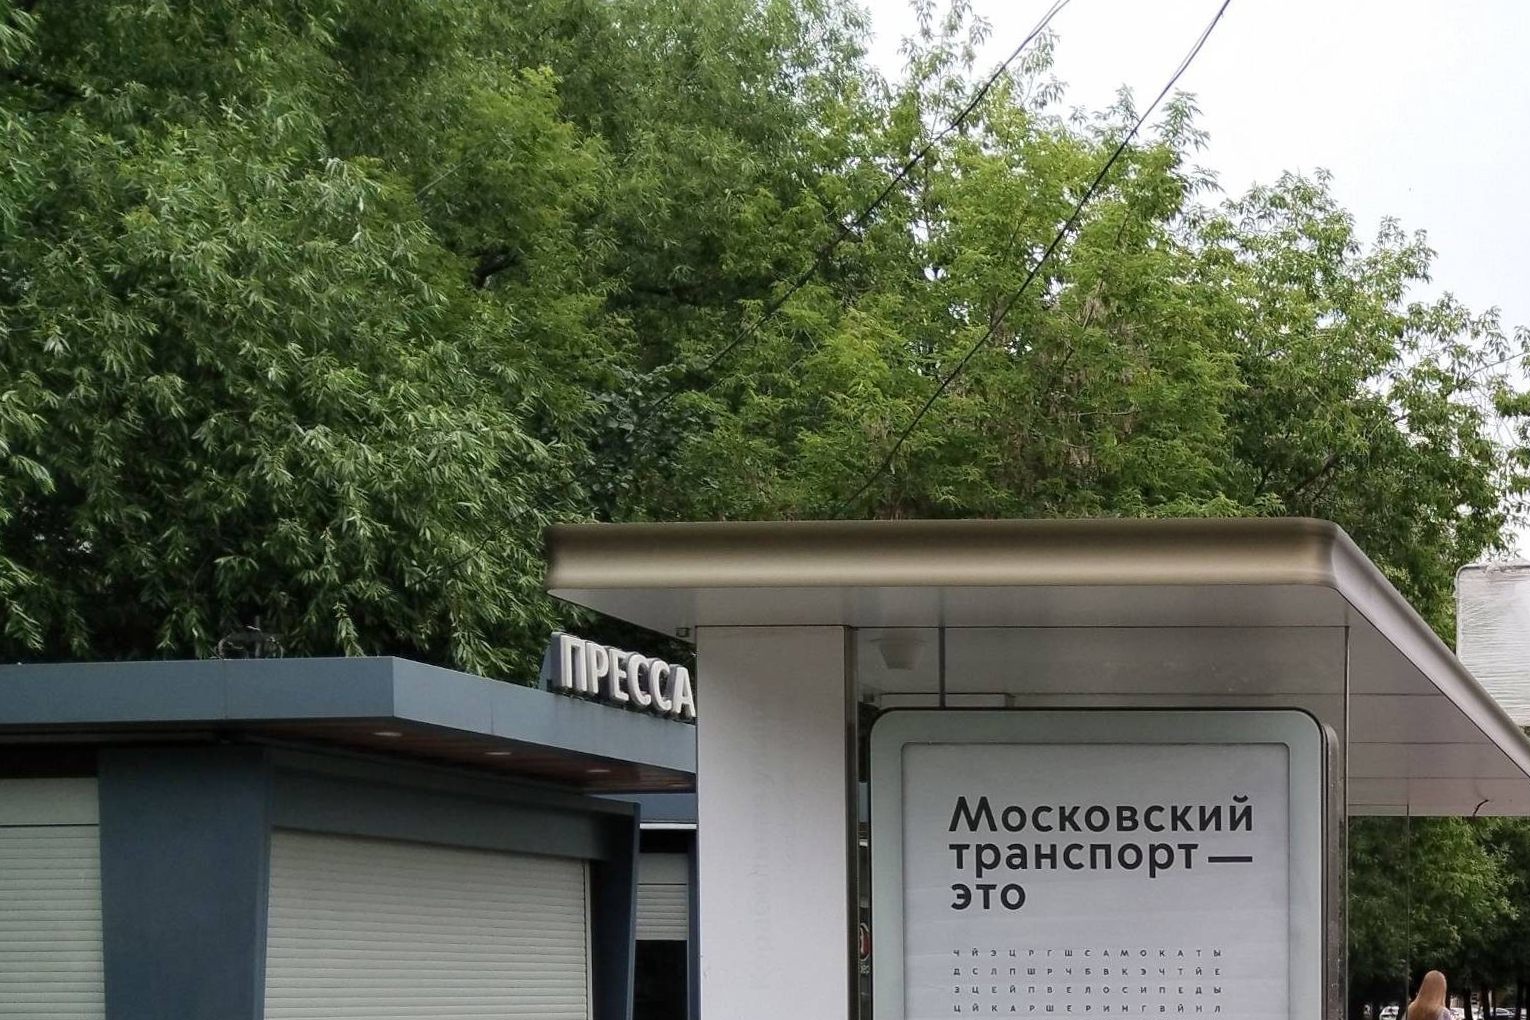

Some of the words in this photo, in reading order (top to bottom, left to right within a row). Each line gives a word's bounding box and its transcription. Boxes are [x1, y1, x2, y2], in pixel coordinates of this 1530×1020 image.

[555, 633, 696, 718] ПРЕССА
[949, 795, 1252, 832] Московский
[949, 843, 1198, 878] транспорт
[951, 884, 1025, 910] это
